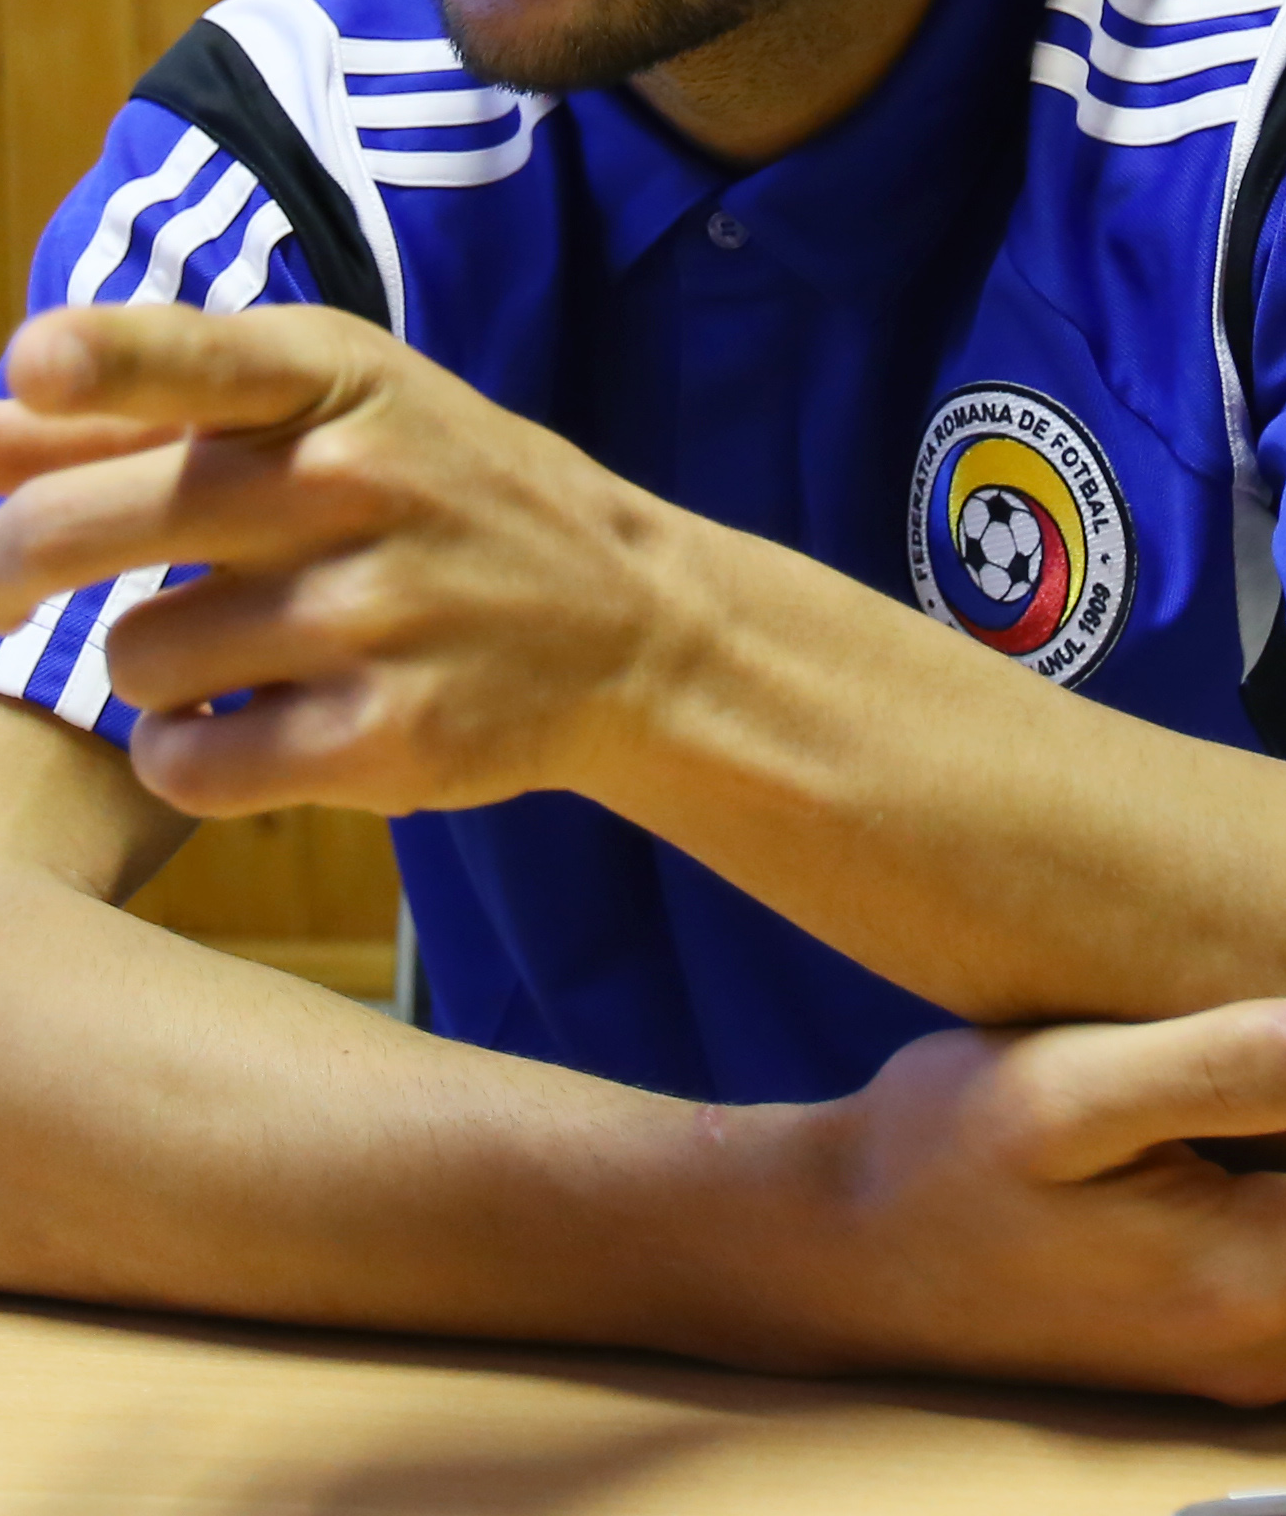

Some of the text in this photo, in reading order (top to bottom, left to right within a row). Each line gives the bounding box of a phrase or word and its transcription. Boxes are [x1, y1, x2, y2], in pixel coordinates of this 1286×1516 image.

[932, 402, 1013, 446] ROMANA
[1018, 408, 1051, 441] DE
[1050, 434, 1110, 535] FOTBAL
[1038, 582, 1111, 677] ANUL 1909
